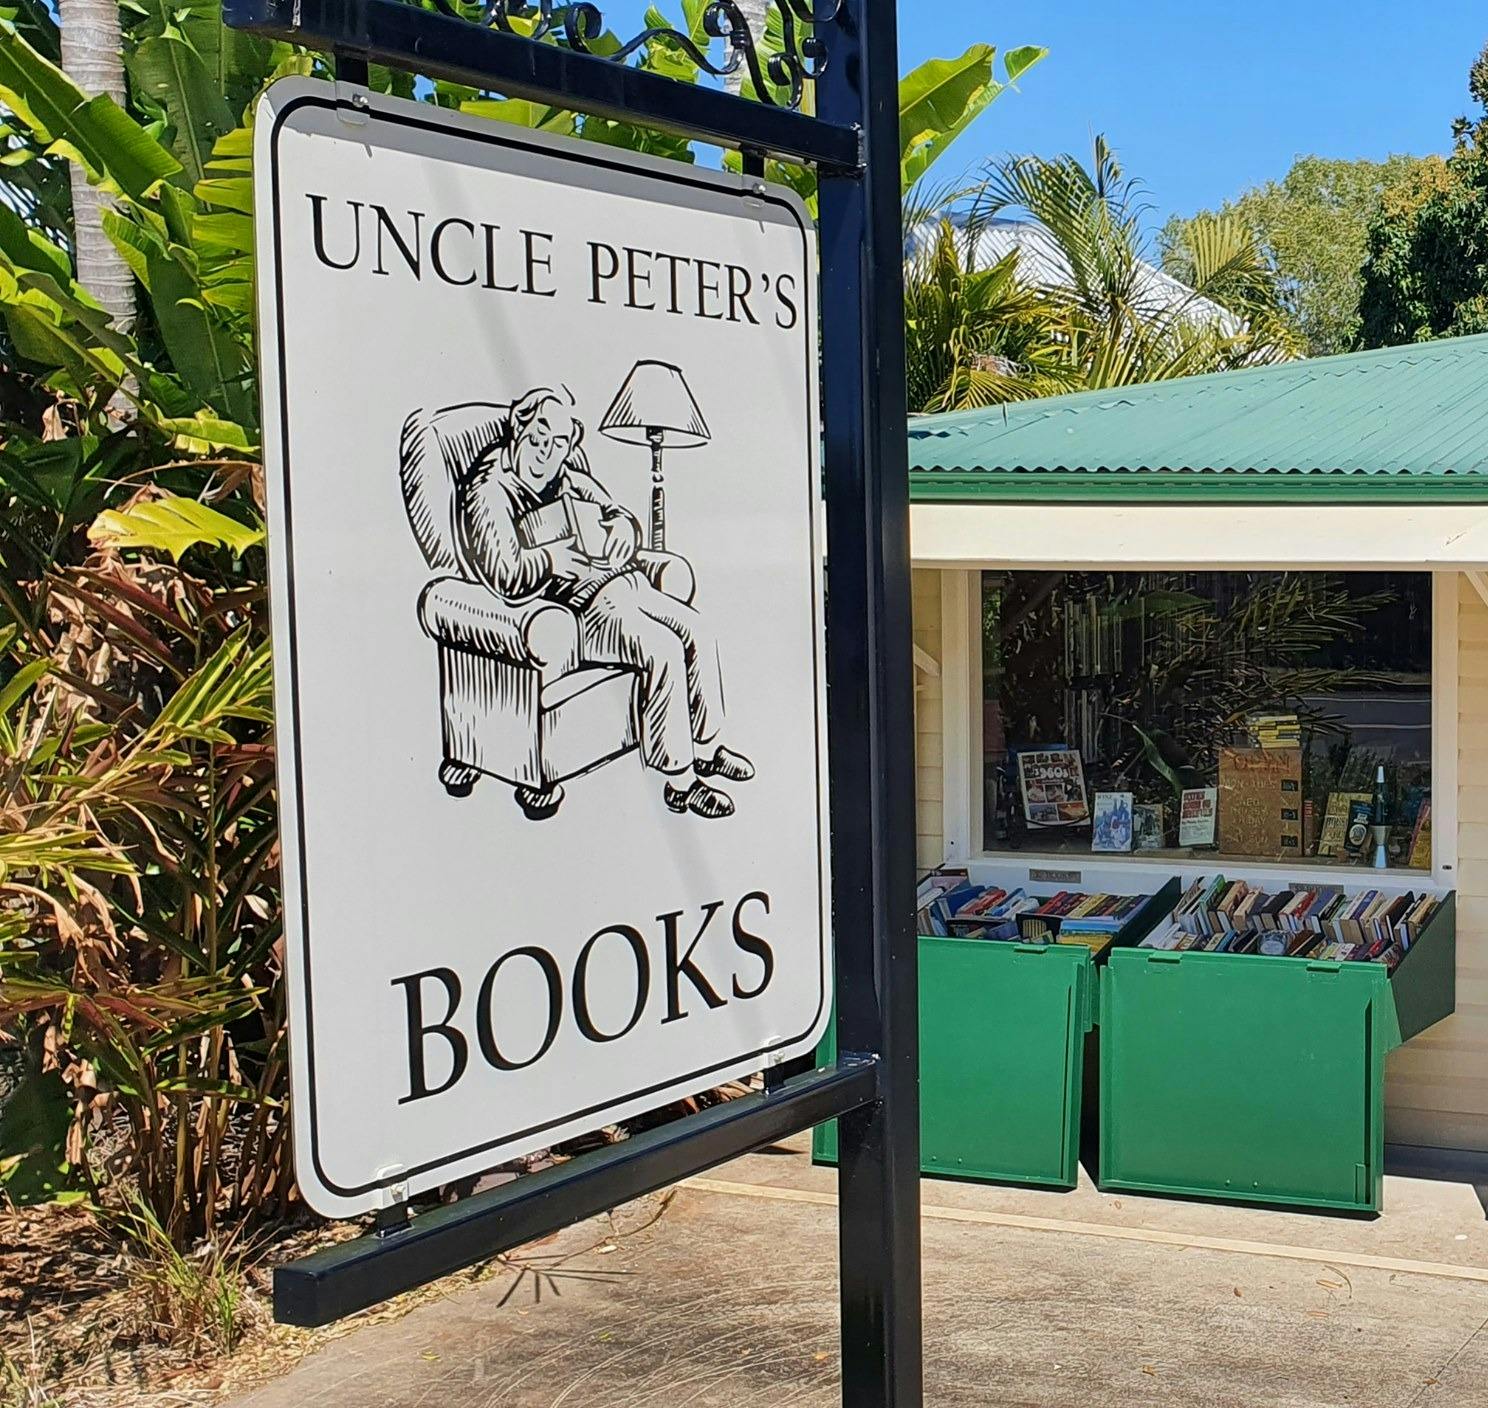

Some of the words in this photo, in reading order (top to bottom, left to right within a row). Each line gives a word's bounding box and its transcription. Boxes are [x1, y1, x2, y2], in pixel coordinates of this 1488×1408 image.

[306, 194, 556, 296] UNCLE
[587, 242, 796, 330] PETER'S
[391, 892, 774, 1105] BOOKS
